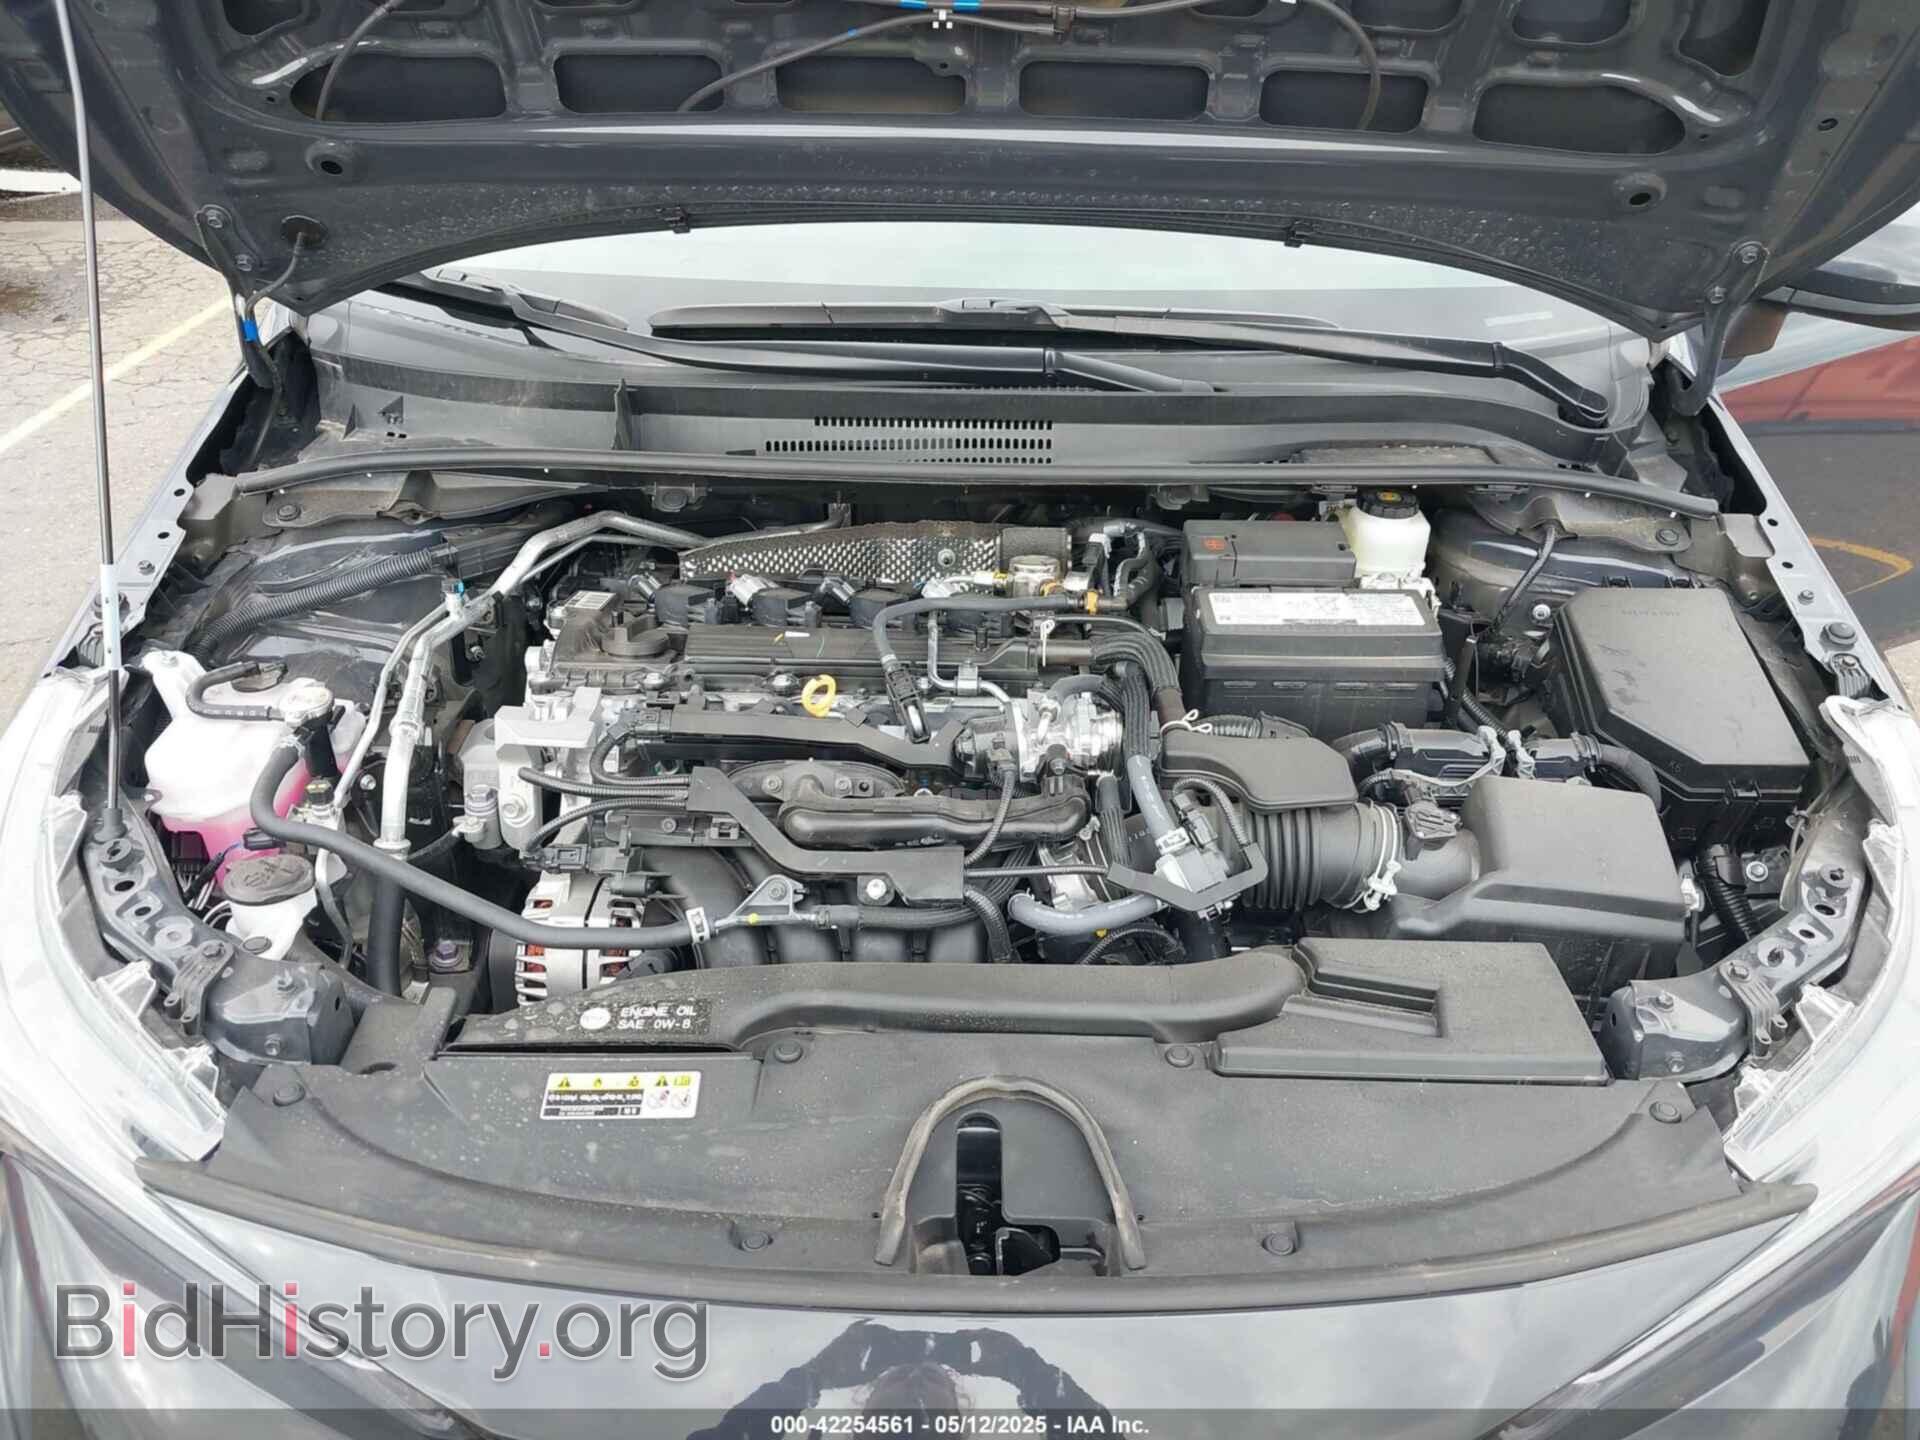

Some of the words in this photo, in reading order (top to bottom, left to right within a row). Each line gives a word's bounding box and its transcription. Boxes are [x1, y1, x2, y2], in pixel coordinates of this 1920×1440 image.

[620, 1006, 670, 1018] ENGINE
[676, 1005, 697, 1017] OIL
[617, 1019, 645, 1030] SAE
